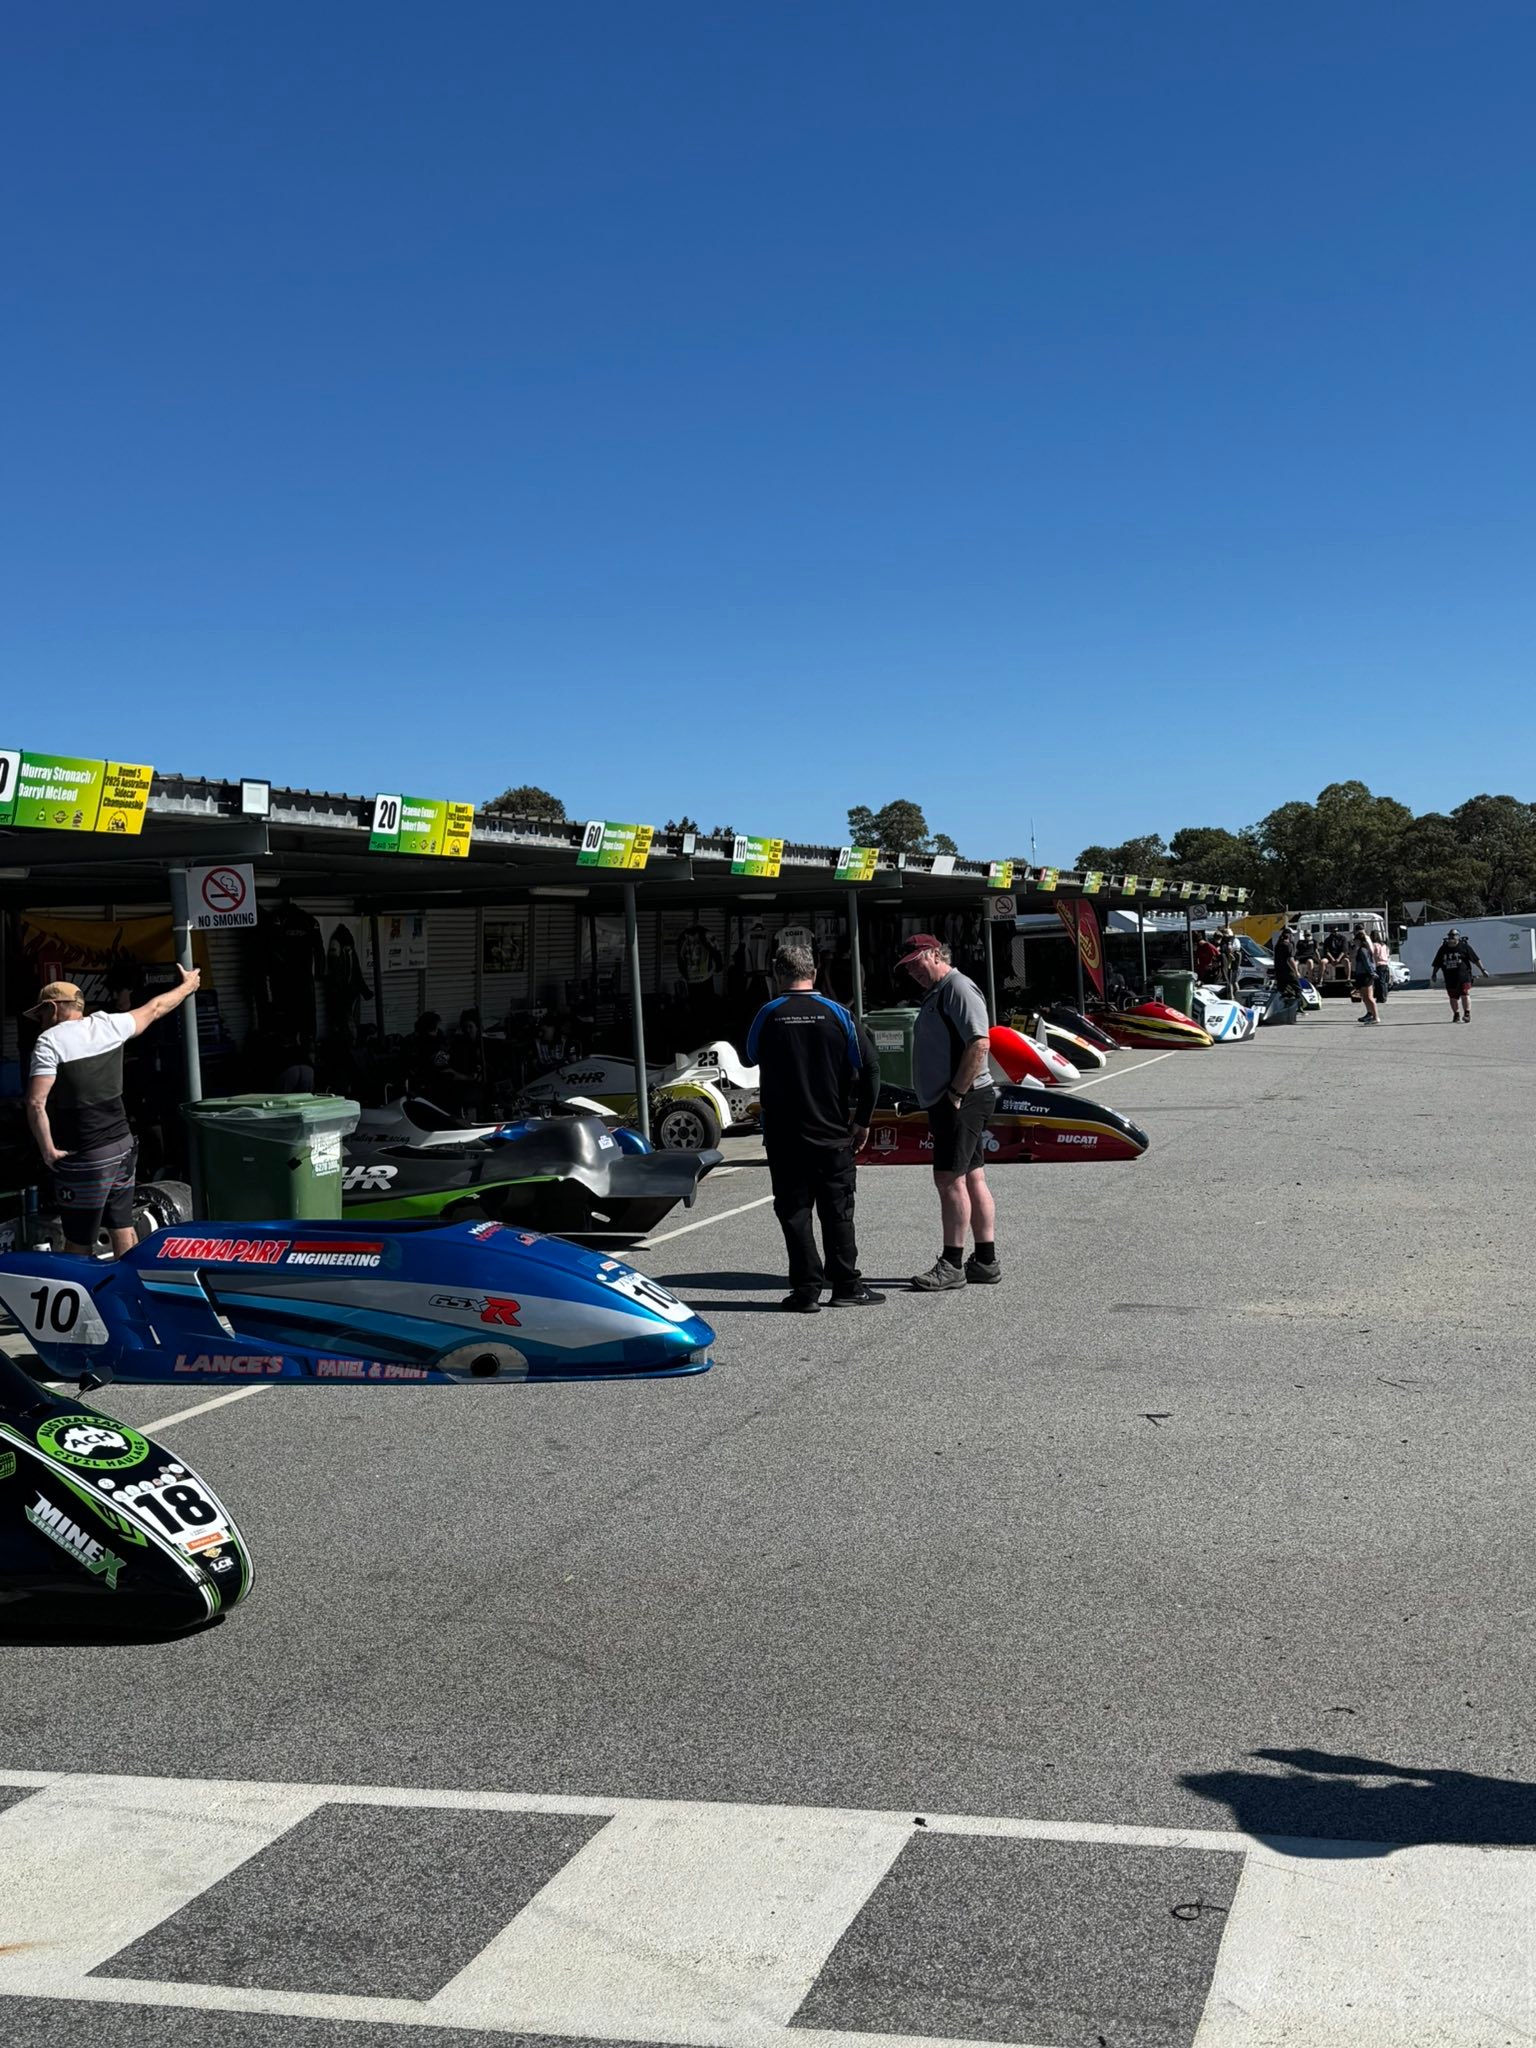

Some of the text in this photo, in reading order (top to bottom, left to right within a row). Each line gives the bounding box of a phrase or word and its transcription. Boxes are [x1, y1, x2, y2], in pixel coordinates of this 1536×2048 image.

[21, 762, 52, 781] Murray
[53, 766, 91, 784] Stronach
[18, 782, 78, 802] Darryl McLeod
[378, 800, 397, 830] 20
[585, 825, 602, 849] 60
[736, 839, 746, 860] 111
[198, 912, 255, 928] NO SMOKING
[1207, 1015, 1224, 1023] 26
[697, 1050, 719, 1068] 23
[1056, 1134, 1098, 1144] DUCATI
[157, 1237, 291, 1264] TURNAPART
[286, 1252, 381, 1268] ENGINEERING
[632, 1280, 680, 1310] 10
[30, 1286, 80, 1333] 10
[174, 1354, 284, 1376] LANCE'S
[316, 1359, 428, 1380] PANEL & PAINT
[39, 1416, 125, 1438] AUSTRALIAN
[71, 1432, 115, 1449] ACH
[53, 1440, 146, 1467] CIVIL HAULAGE
[133, 1485, 218, 1535] 18
[33, 1516, 96, 1567] TRANSPORT
